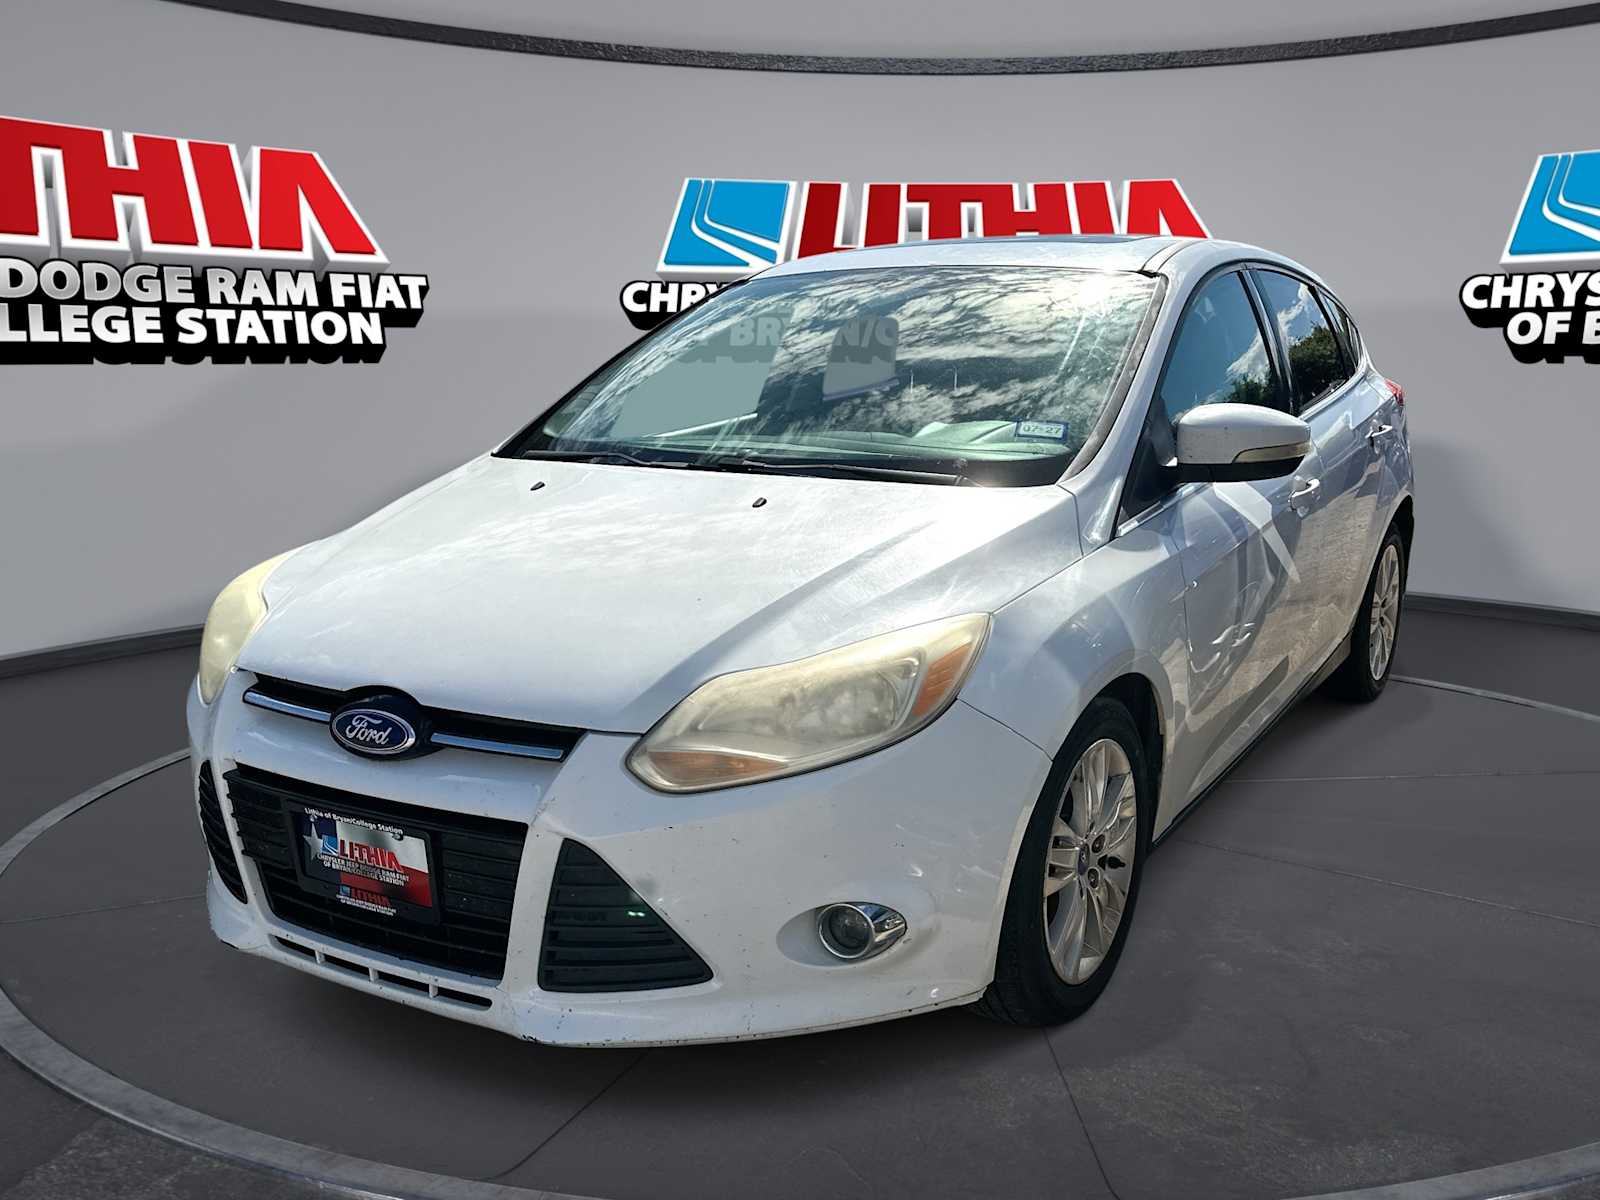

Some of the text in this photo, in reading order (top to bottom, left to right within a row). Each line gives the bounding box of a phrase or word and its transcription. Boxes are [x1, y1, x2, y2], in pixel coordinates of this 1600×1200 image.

[796, 180, 1210, 259] LITHIA
[0, 258, 427, 309] DODGE RAM FIAT
[177, 307, 384, 345] STATION
[1507, 312, 1572, 345] OF
[345, 714, 392, 744] Ford
[338, 839, 403, 873] LITHIA
